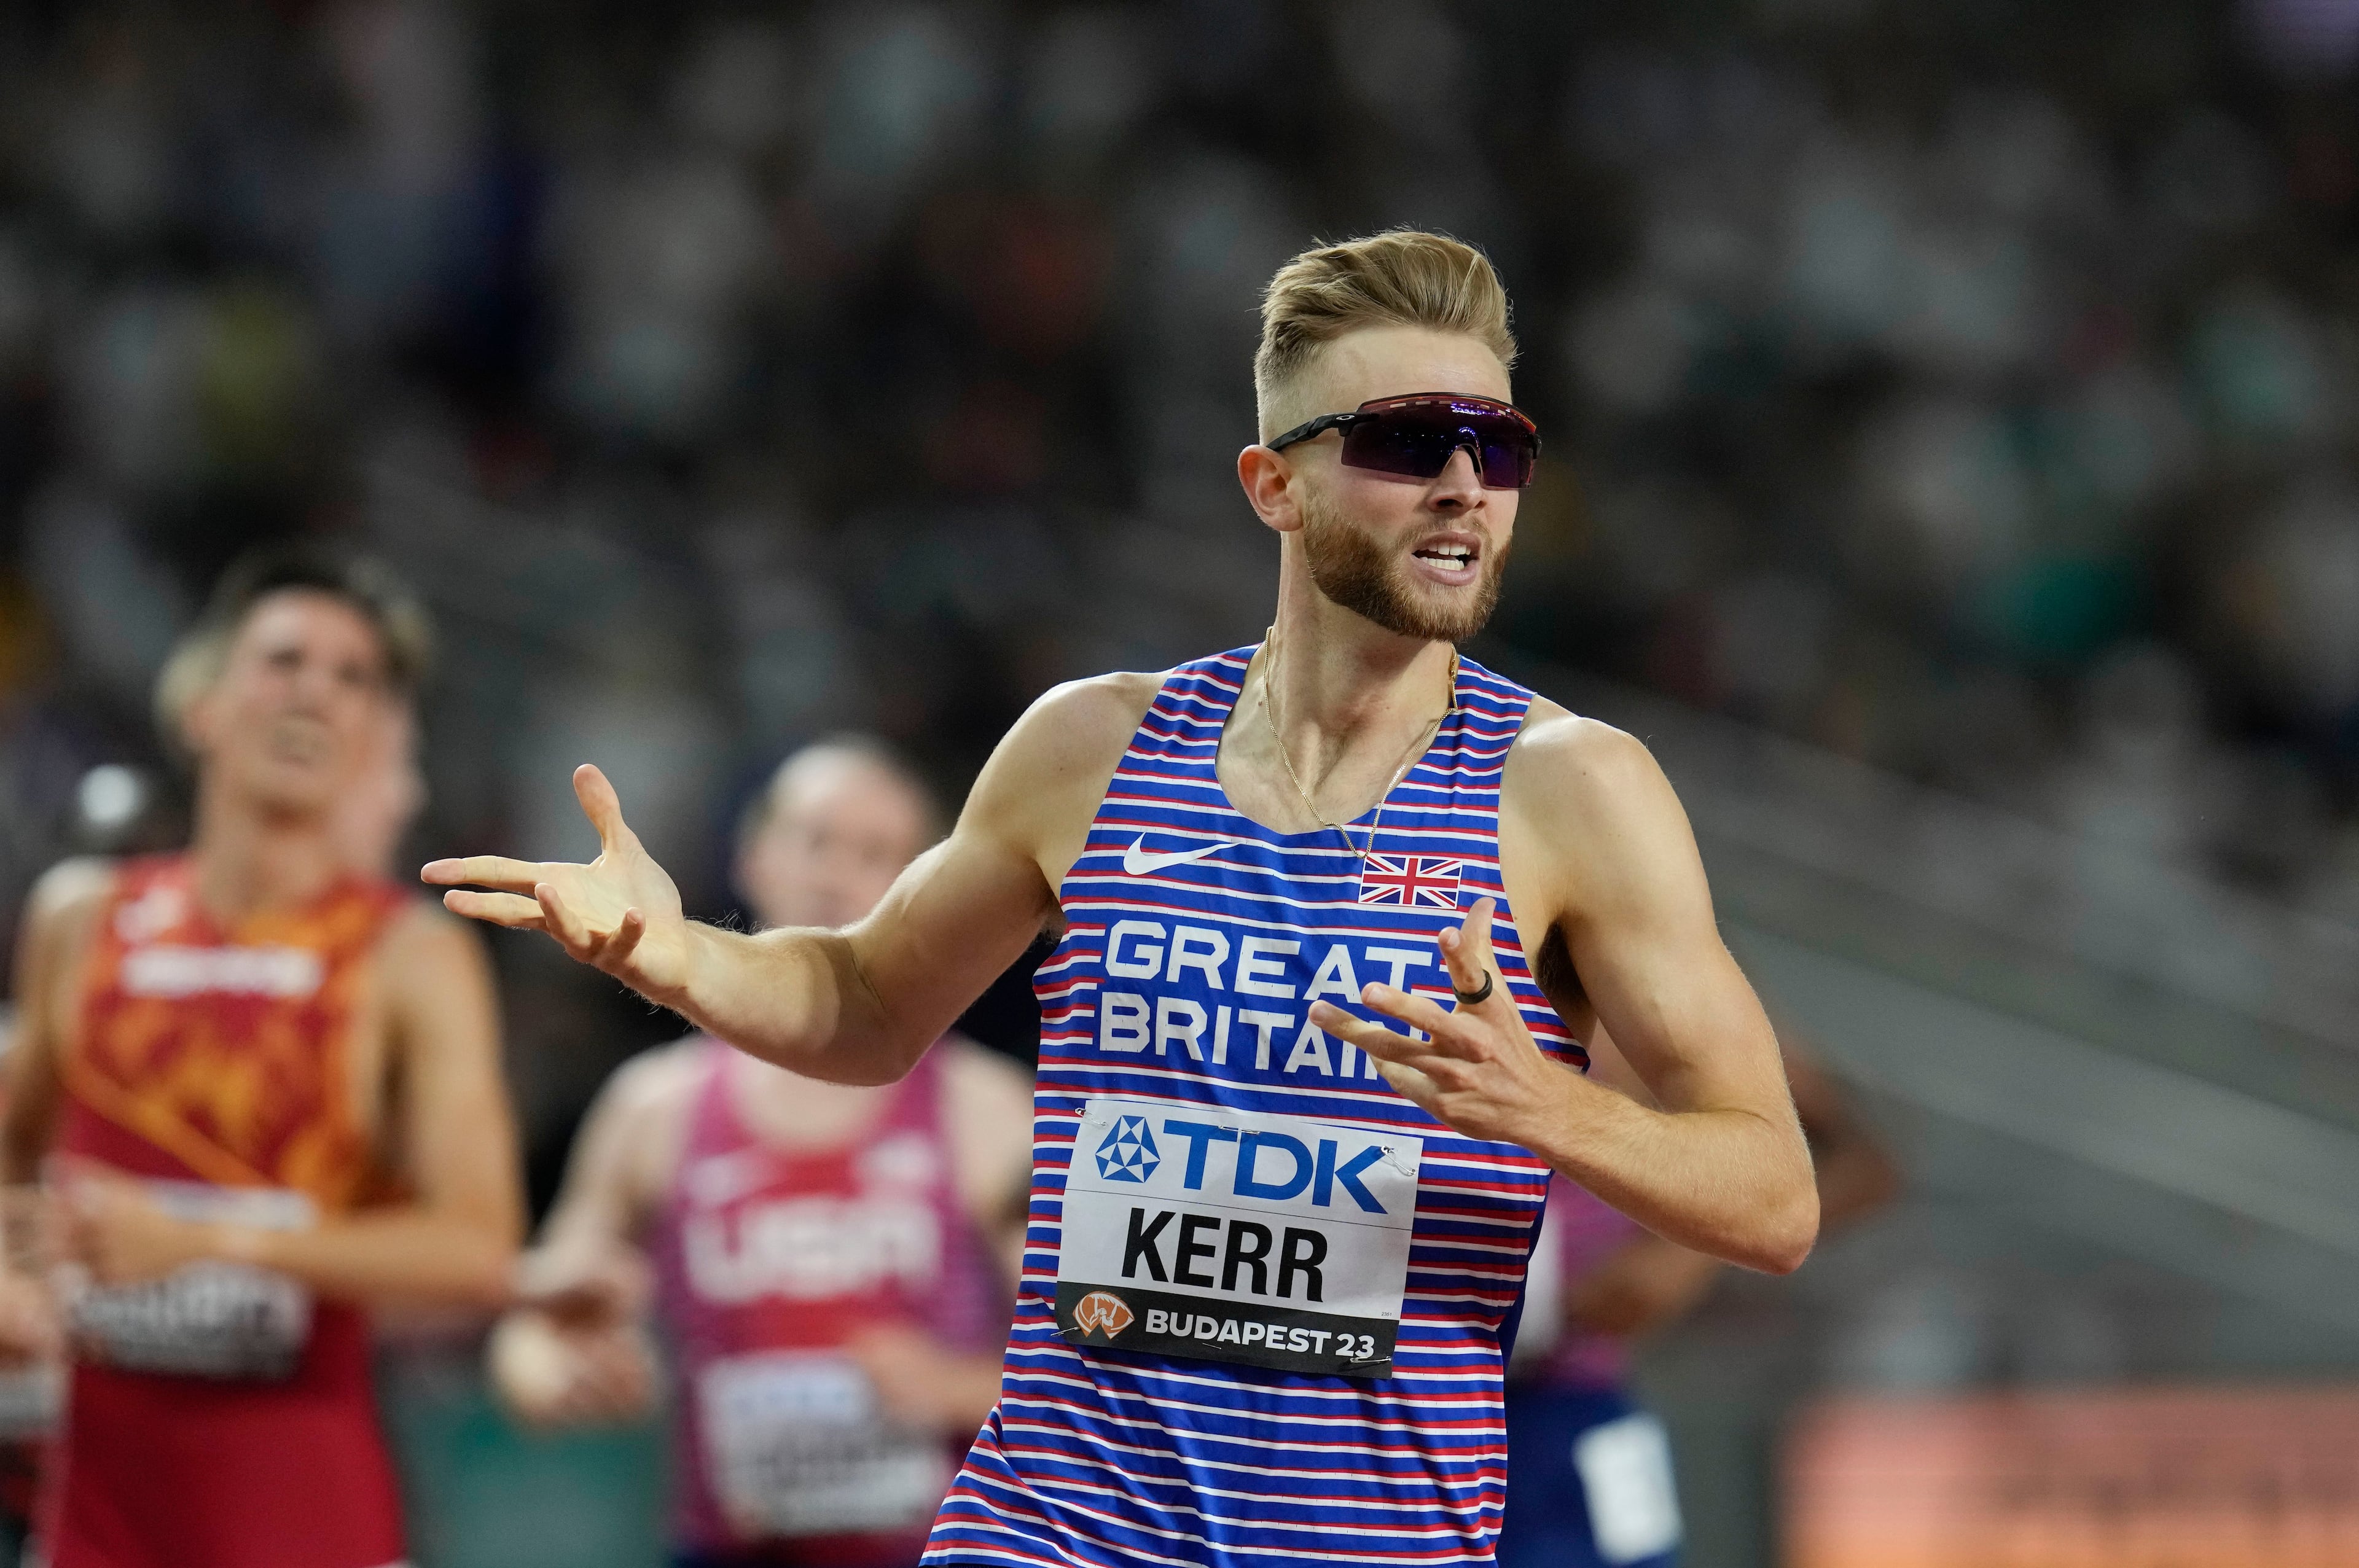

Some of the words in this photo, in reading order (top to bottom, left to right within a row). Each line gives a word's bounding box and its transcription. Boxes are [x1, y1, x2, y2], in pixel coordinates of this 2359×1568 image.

[1105, 919, 1432, 1005] GREAT
[1163, 1119, 1388, 1214] TDK
[1121, 1207, 1328, 1303] KERR
[1145, 1309, 1332, 1355] BUDAPEST
[1335, 1333, 1375, 1359] 23
